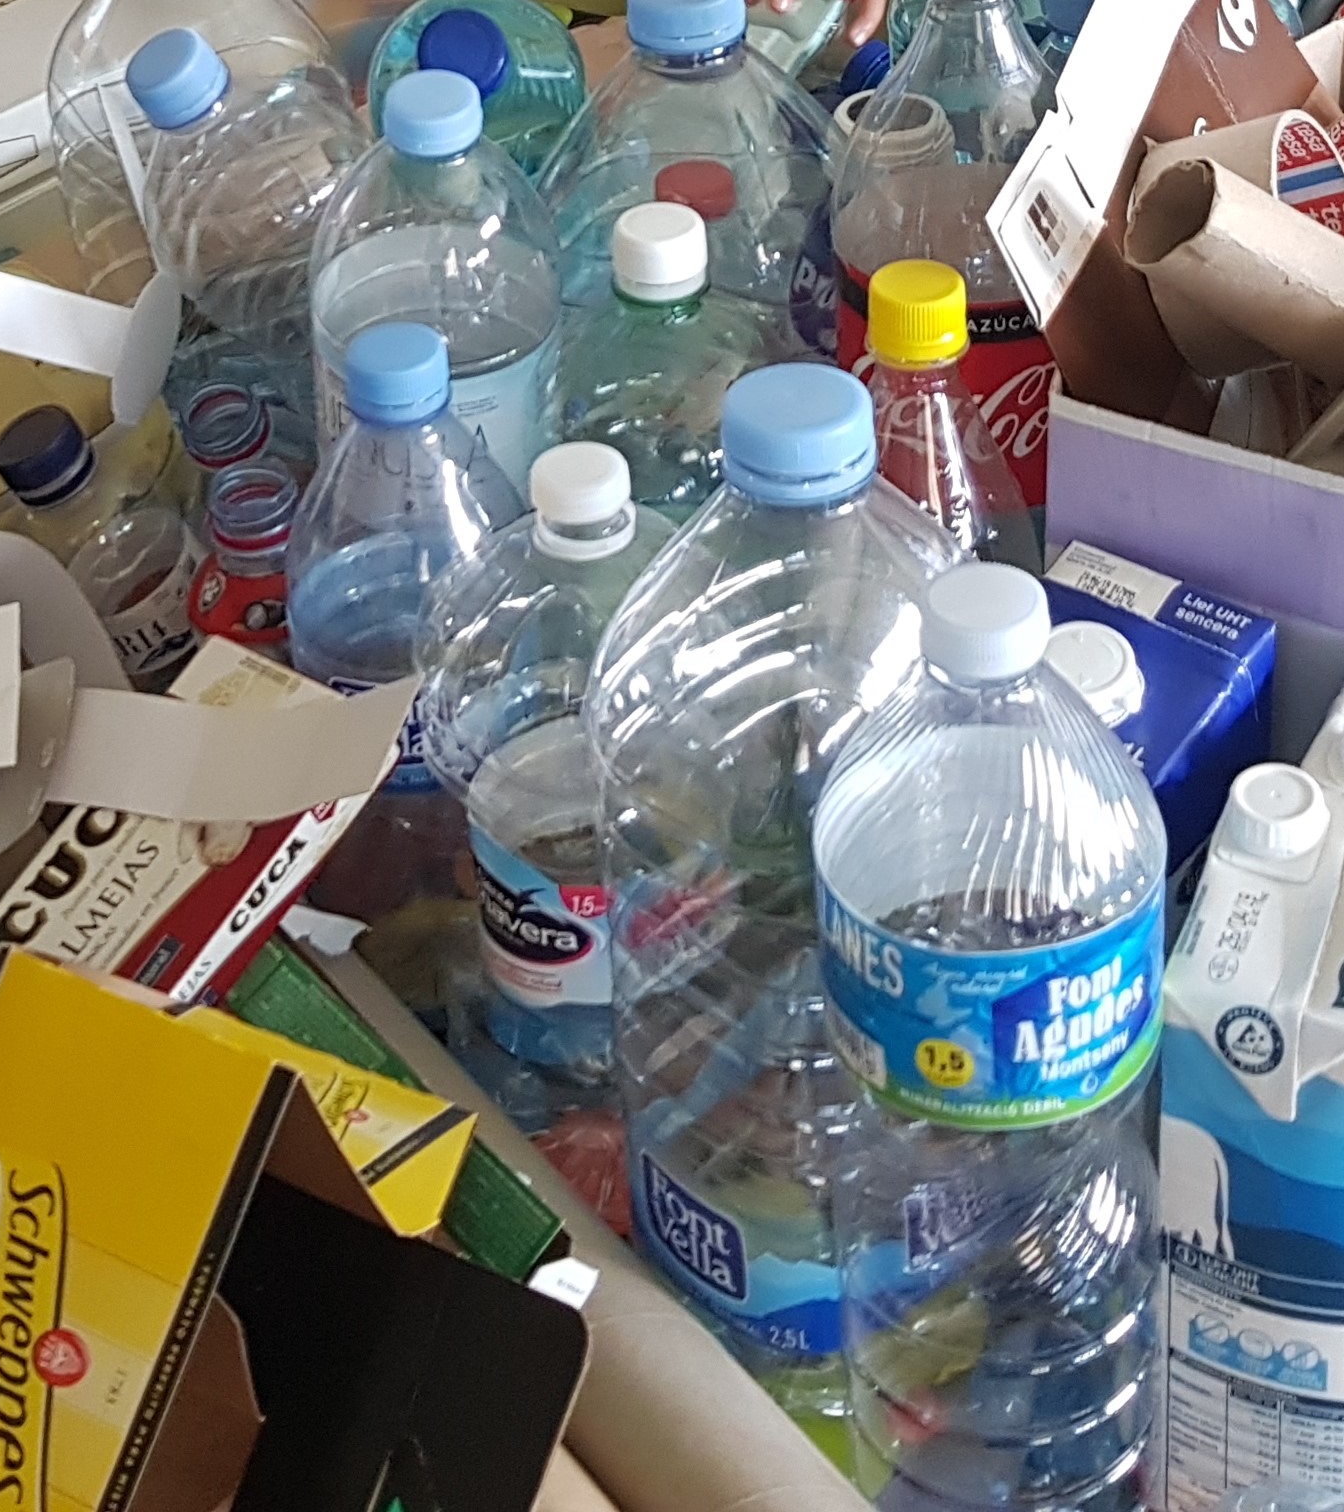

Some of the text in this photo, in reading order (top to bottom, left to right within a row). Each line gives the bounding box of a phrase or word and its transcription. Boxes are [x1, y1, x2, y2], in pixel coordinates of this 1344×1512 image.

[1321, 202, 1343, 233] te
[966, 313, 1039, 334] AZÚCA
[1174, 606, 1239, 641] sencera
[1182, 591, 1253, 629] Llet UHT
[58, 837, 161, 958] LMEJAS
[228, 837, 308, 936] CUCA
[1046, 955, 1124, 1016] Font
[1012, 973, 1146, 1065] Agudes
[1039, 1027, 1130, 1081] Montseny
[652, 1164, 732, 1258] Font
[656, 1212, 737, 1293] Vella
